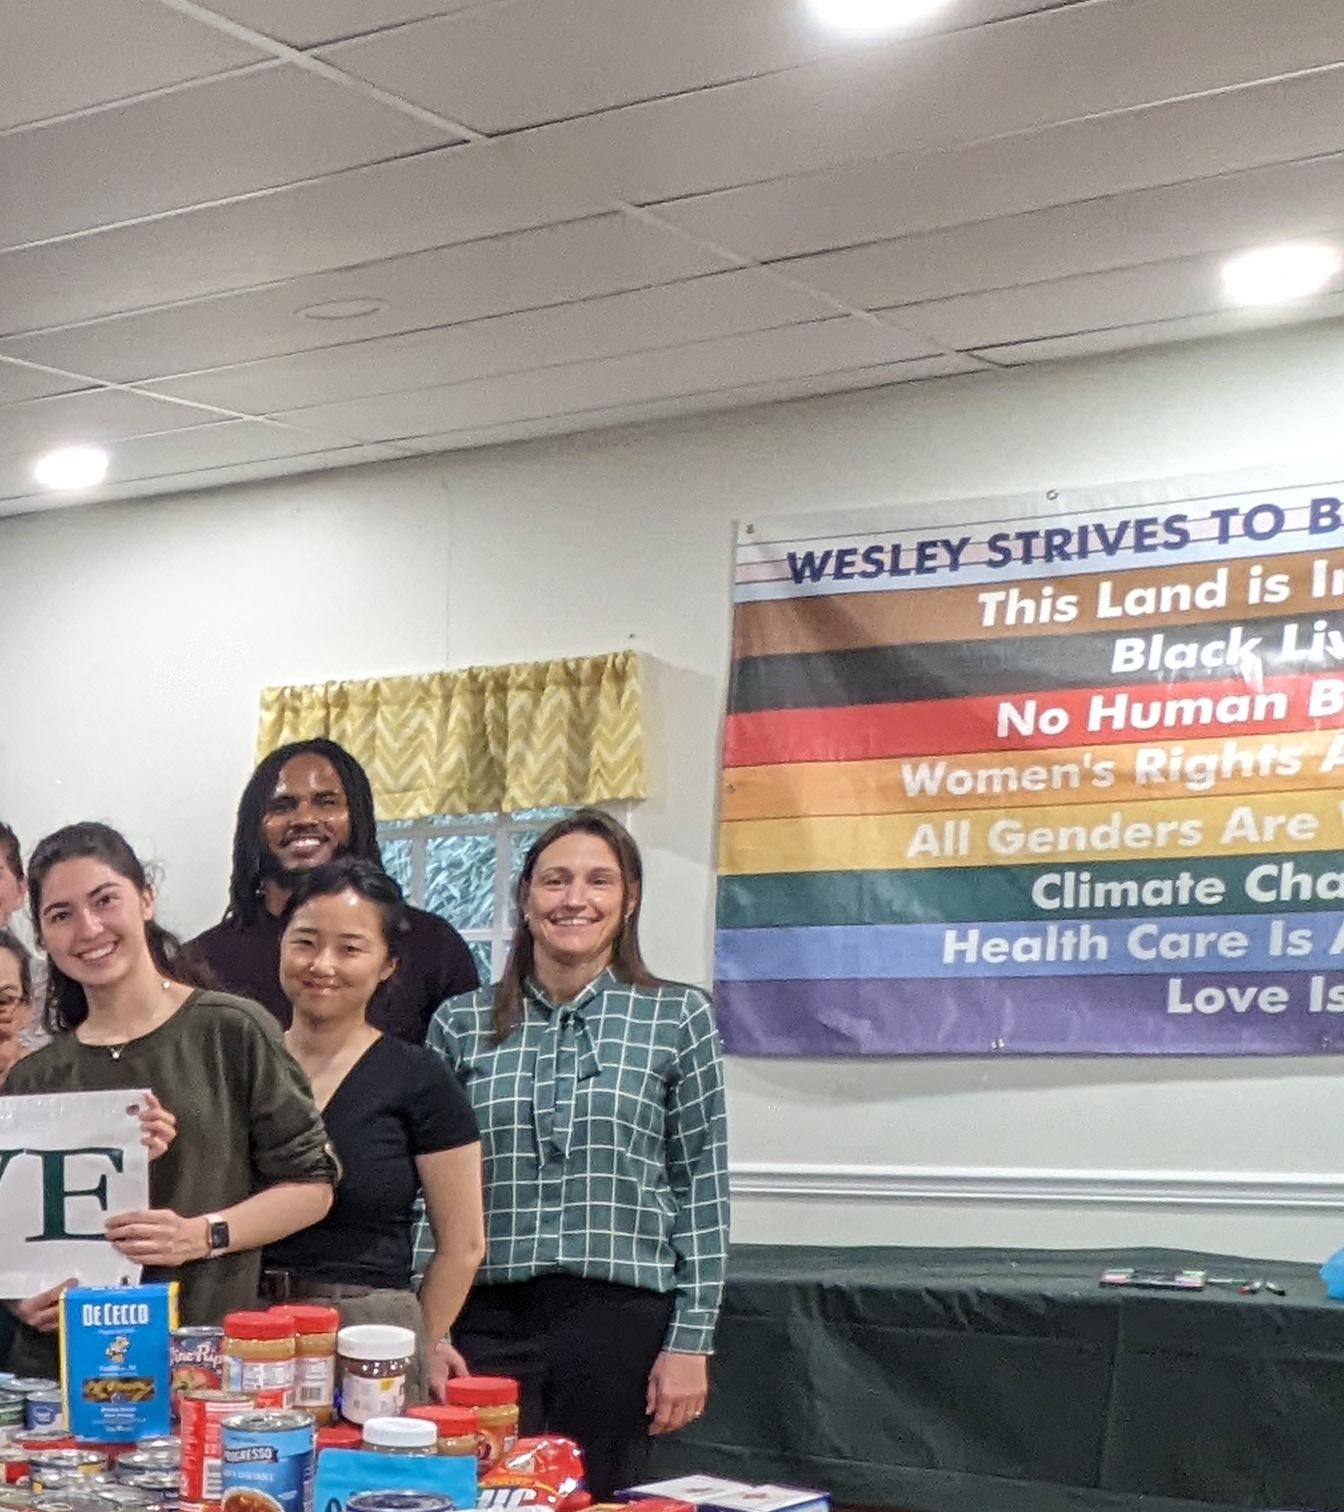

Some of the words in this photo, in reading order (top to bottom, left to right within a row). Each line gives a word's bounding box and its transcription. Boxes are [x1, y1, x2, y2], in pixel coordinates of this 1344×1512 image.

[787, 537, 970, 585] WESLEY
[987, 514, 1190, 568] STRIVES
[1210, 503, 1285, 544] TO
[977, 590, 1078, 628] This
[1096, 567, 1229, 619] Land
[1248, 565, 1291, 604] is
[1110, 629, 1262, 674] Black
[996, 699, 1070, 740] No
[1086, 690, 1288, 733] Human
[900, 751, 1116, 797] Women's
[1134, 740, 1302, 791] Rights
[905, 818, 971, 860] All
[987, 811, 1202, 854] Genders
[1219, 806, 1320, 846] Are
[1031, 869, 1227, 911] Climate
[942, 925, 1108, 966] Health
[1126, 921, 1250, 962] Care
[1268, 918, 1314, 956] Is
[1166, 976, 1290, 1016] Love
[82, 1303, 102, 1327] DE
[103, 1303, 150, 1326] CECCO
